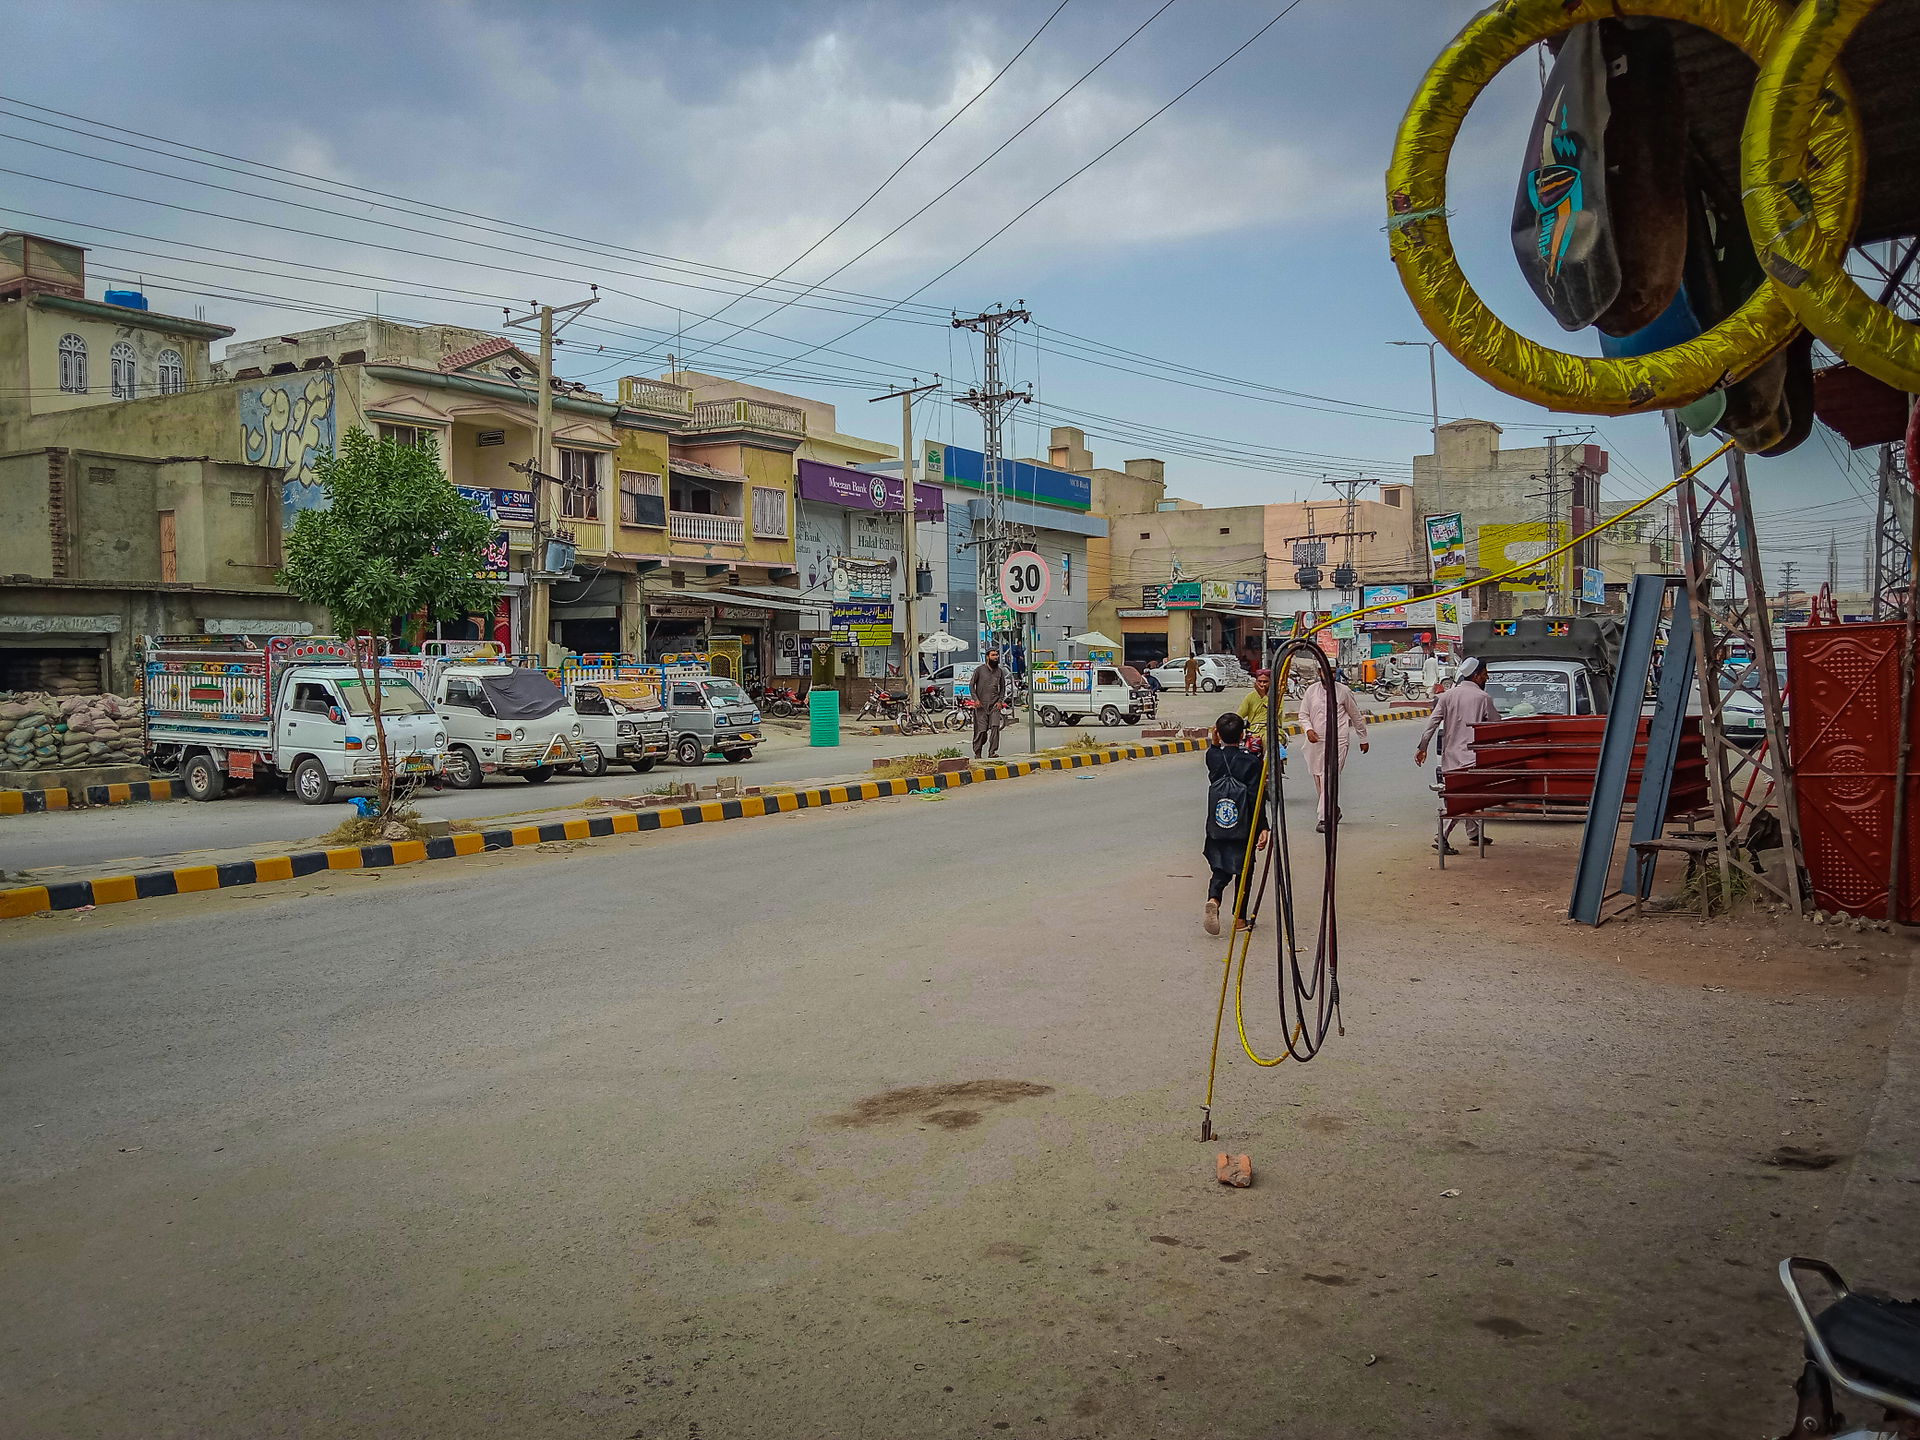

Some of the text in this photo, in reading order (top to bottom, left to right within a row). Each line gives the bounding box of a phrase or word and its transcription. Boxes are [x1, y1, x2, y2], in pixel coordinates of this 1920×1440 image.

[829, 477, 851, 490] Meezan
[852, 481, 868, 494] Bank
[804, 532, 821, 542] Bank
[858, 535, 878, 548] Halal
[838, 575, 843, 583] 5
[1009, 564, 1040, 593] 30
[1018, 596, 1035, 604] HTV
